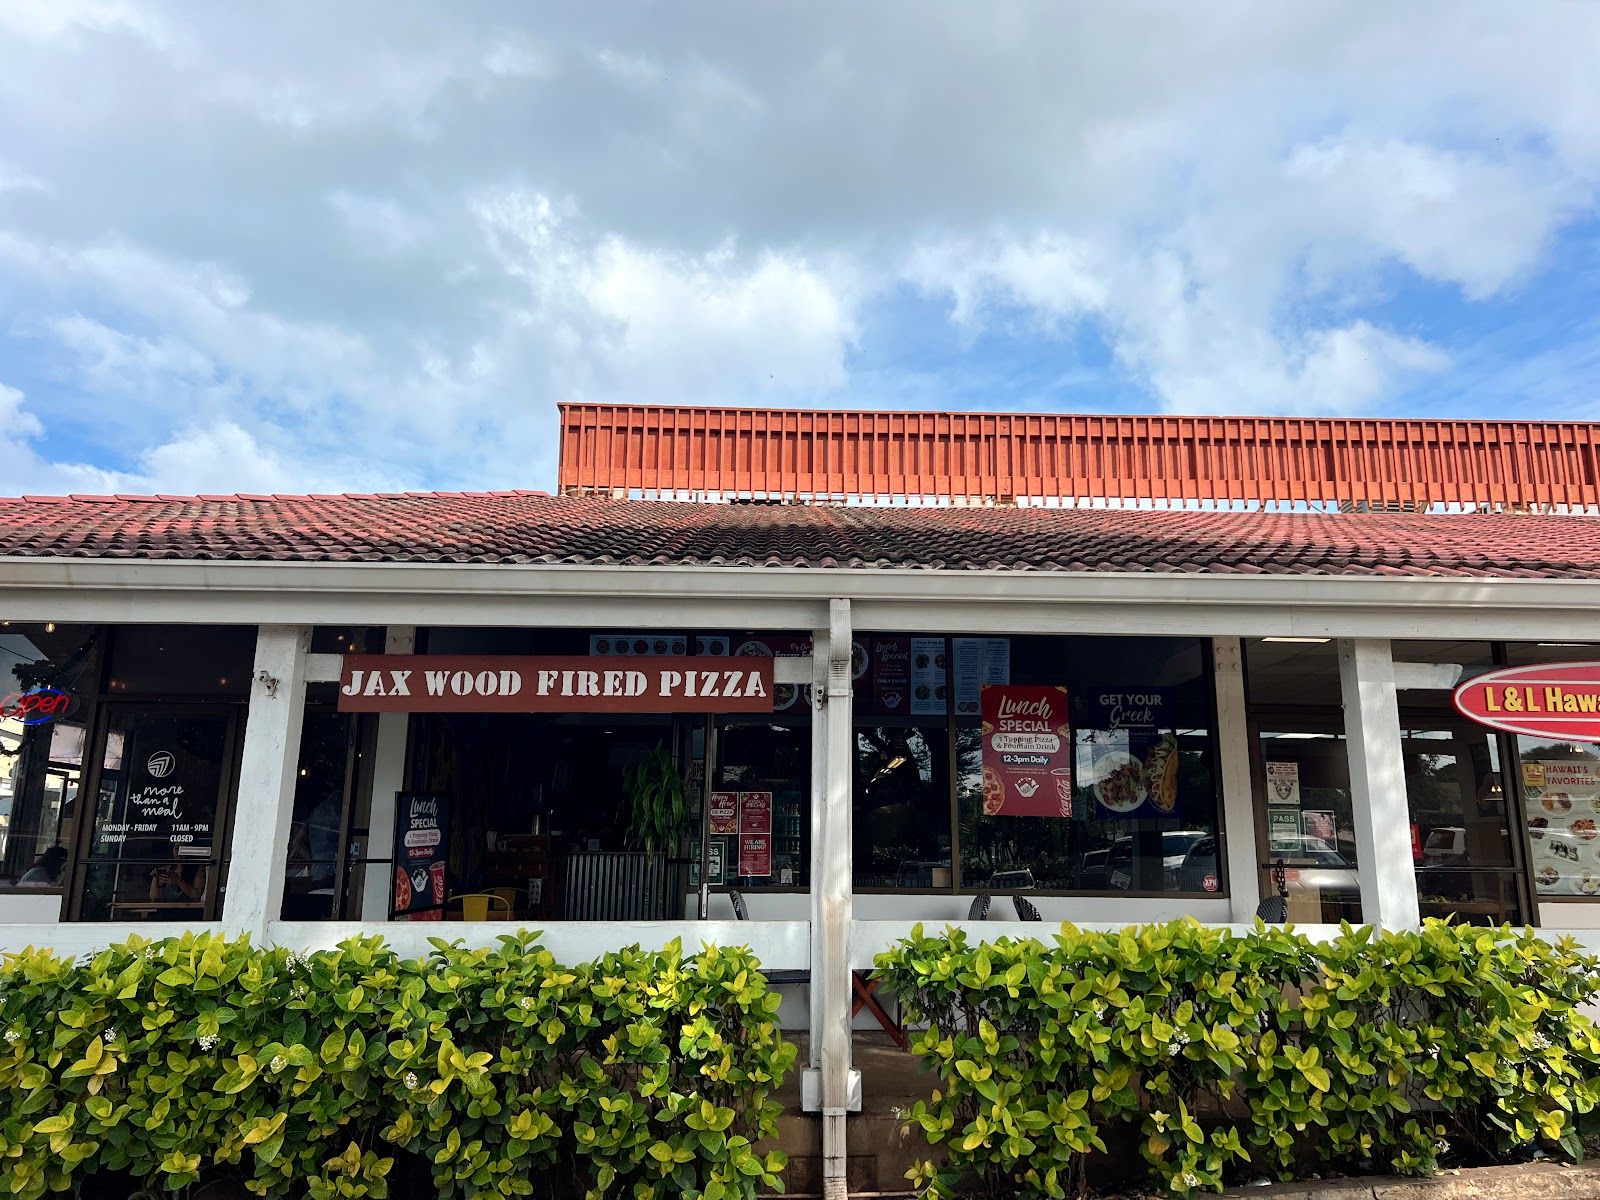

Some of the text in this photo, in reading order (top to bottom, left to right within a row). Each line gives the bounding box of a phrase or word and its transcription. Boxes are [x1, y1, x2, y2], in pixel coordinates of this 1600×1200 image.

[342, 670, 767, 698] JAX WOOD FIRED PIZZA
[1099, 694, 1164, 706] GET YOUR
[1545, 687, 1600, 712] Haw
[997, 694, 1053, 720] Lunch
[1109, 705, 1154, 728] Greek
[1000, 720, 1052, 732] SPECIAL
[1004, 736, 1033, 744] Topping
[1003, 755, 1049, 765] 12-3pm Daily
[1546, 765, 1589, 774] HAWAII'S
[1547, 777, 1596, 786] FAVORITES
[144, 785, 184, 796] more
[130, 793, 170, 806] than a
[142, 798, 182, 819] meal
[410, 796, 438, 818] Lunch
[102, 824, 130, 832] MONDAY
[134, 824, 157, 832] FRIDAY
[172, 824, 190, 832] 11AM
[194, 824, 209, 832] 9PM
[411, 818, 438, 829] SPECIAL
[100, 835, 127, 843] SUNDAY
[169, 835, 194, 843] CLOSED
[696, 847, 719, 856] PSS
